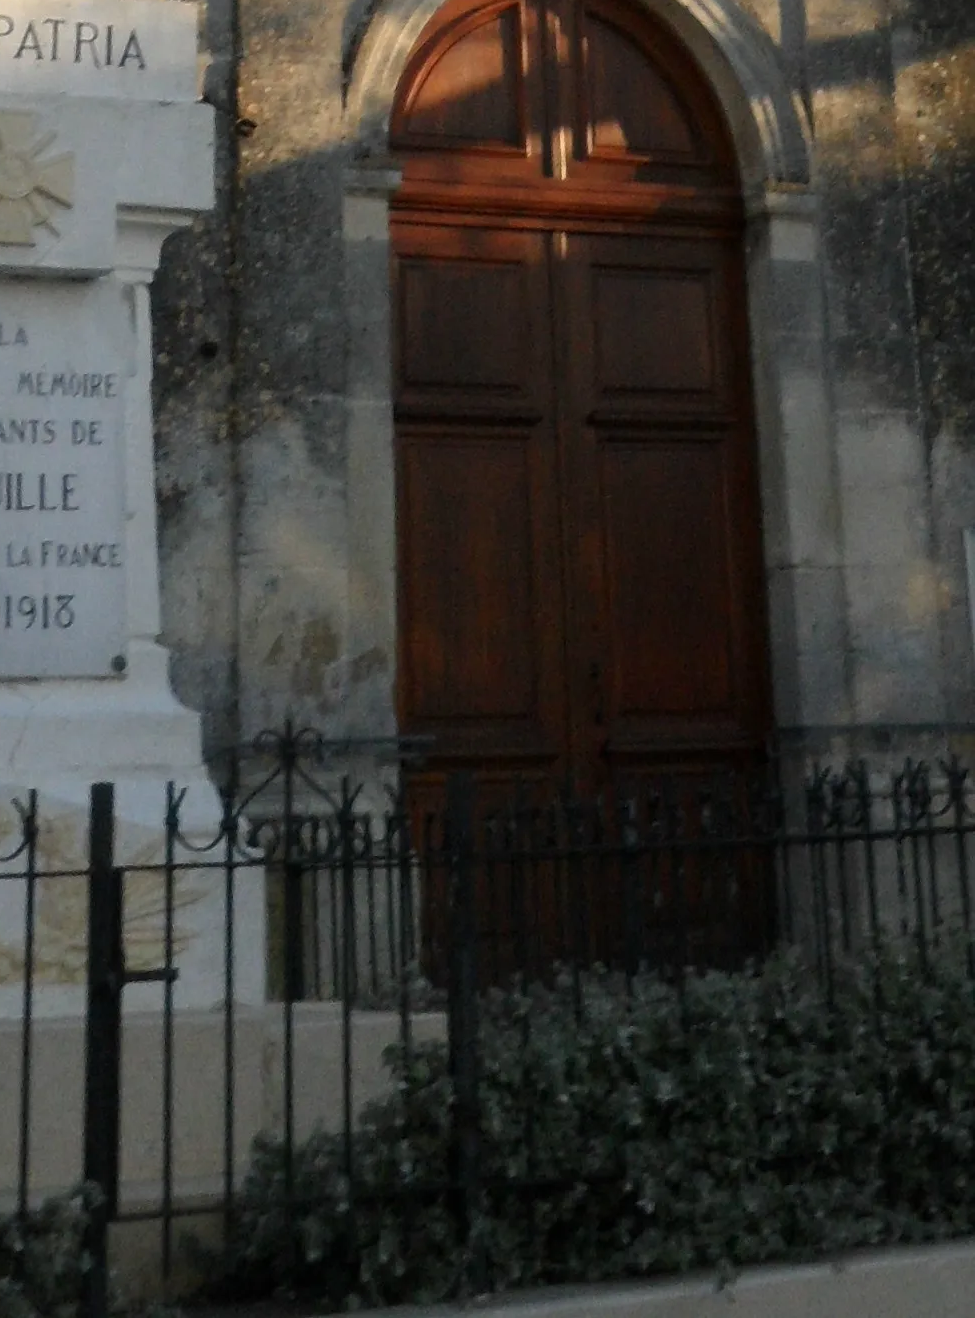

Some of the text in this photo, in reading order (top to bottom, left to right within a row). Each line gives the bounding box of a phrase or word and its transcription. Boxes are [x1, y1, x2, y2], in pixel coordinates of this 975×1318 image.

[72, 419, 104, 446] DE
[6, 539, 34, 569] LA
[40, 540, 124, 569] FRANCE
